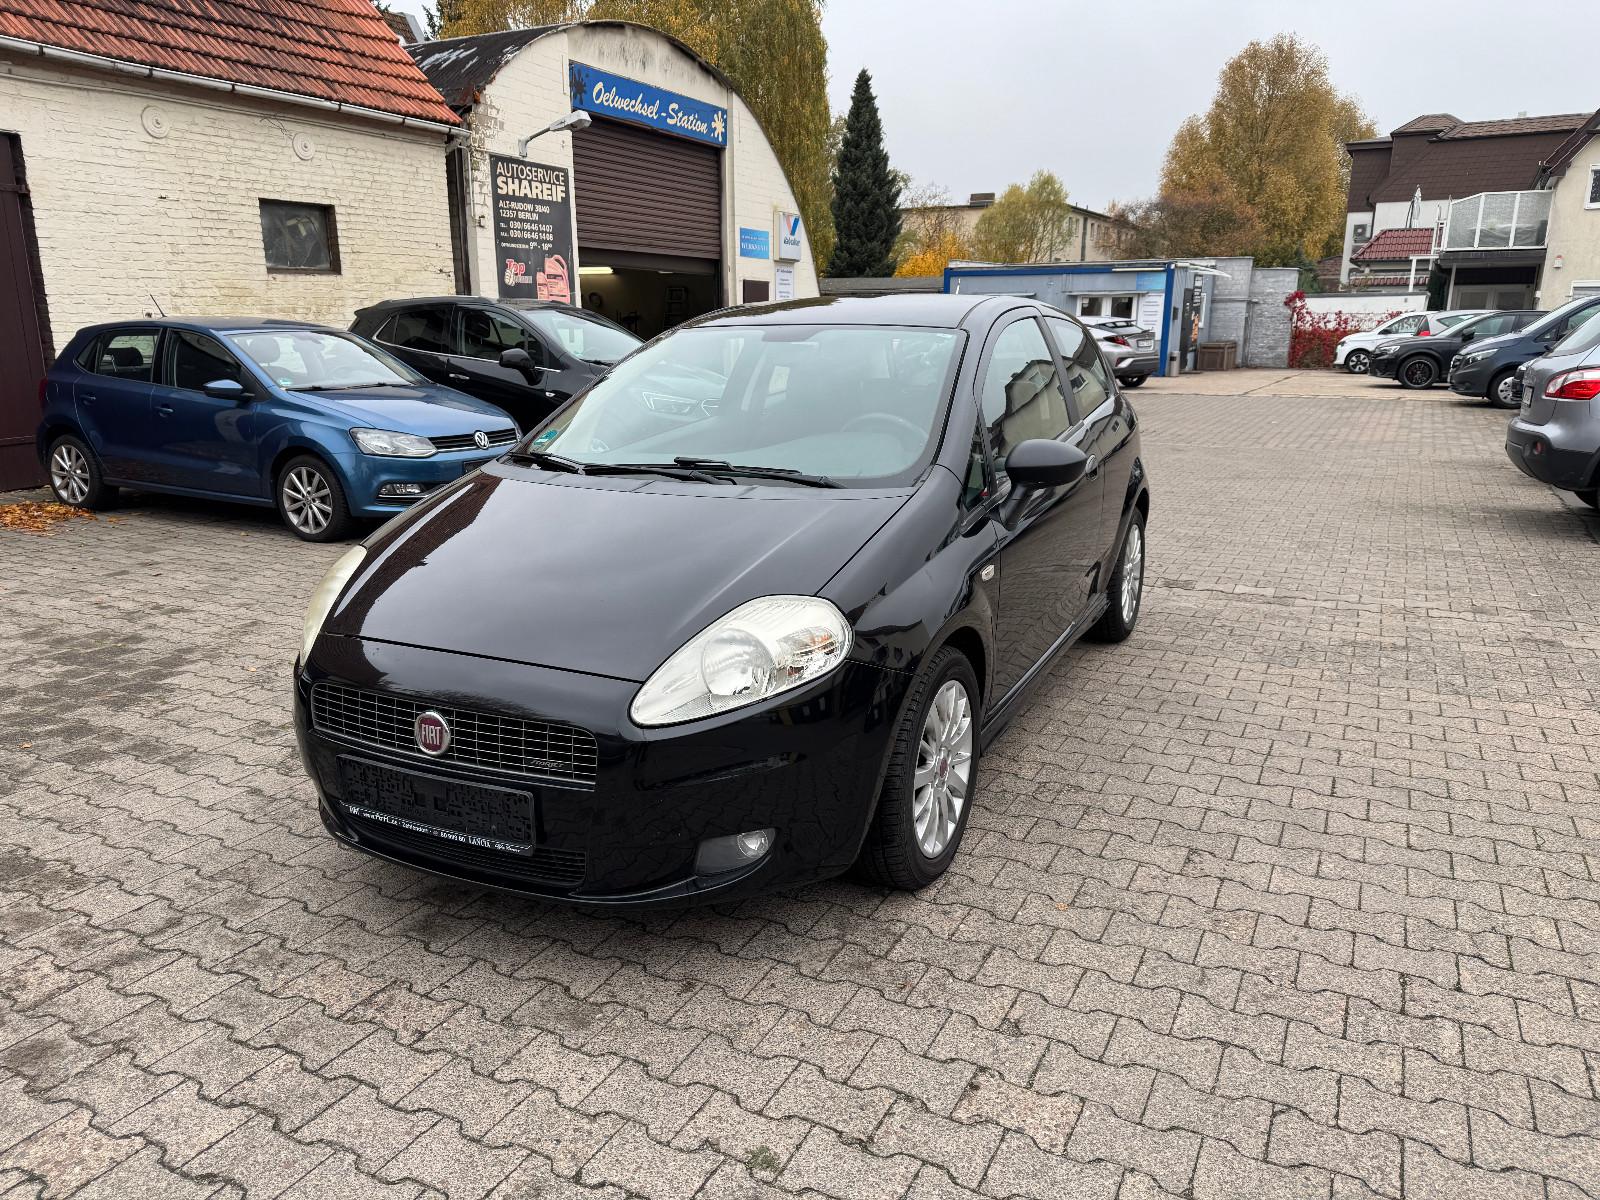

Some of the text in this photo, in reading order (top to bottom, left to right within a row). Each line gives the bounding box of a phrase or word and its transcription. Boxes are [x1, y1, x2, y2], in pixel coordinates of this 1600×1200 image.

[496, 162, 565, 185] AUTOSERVICE
[497, 176, 566, 202] SHAREIF
[498, 200, 534, 212] ALT-RUDOW
[500, 209, 539, 220] 12357 BERLIN
[421, 723, 443, 746] FIAT
[468, 836, 491, 848] LANCIA
